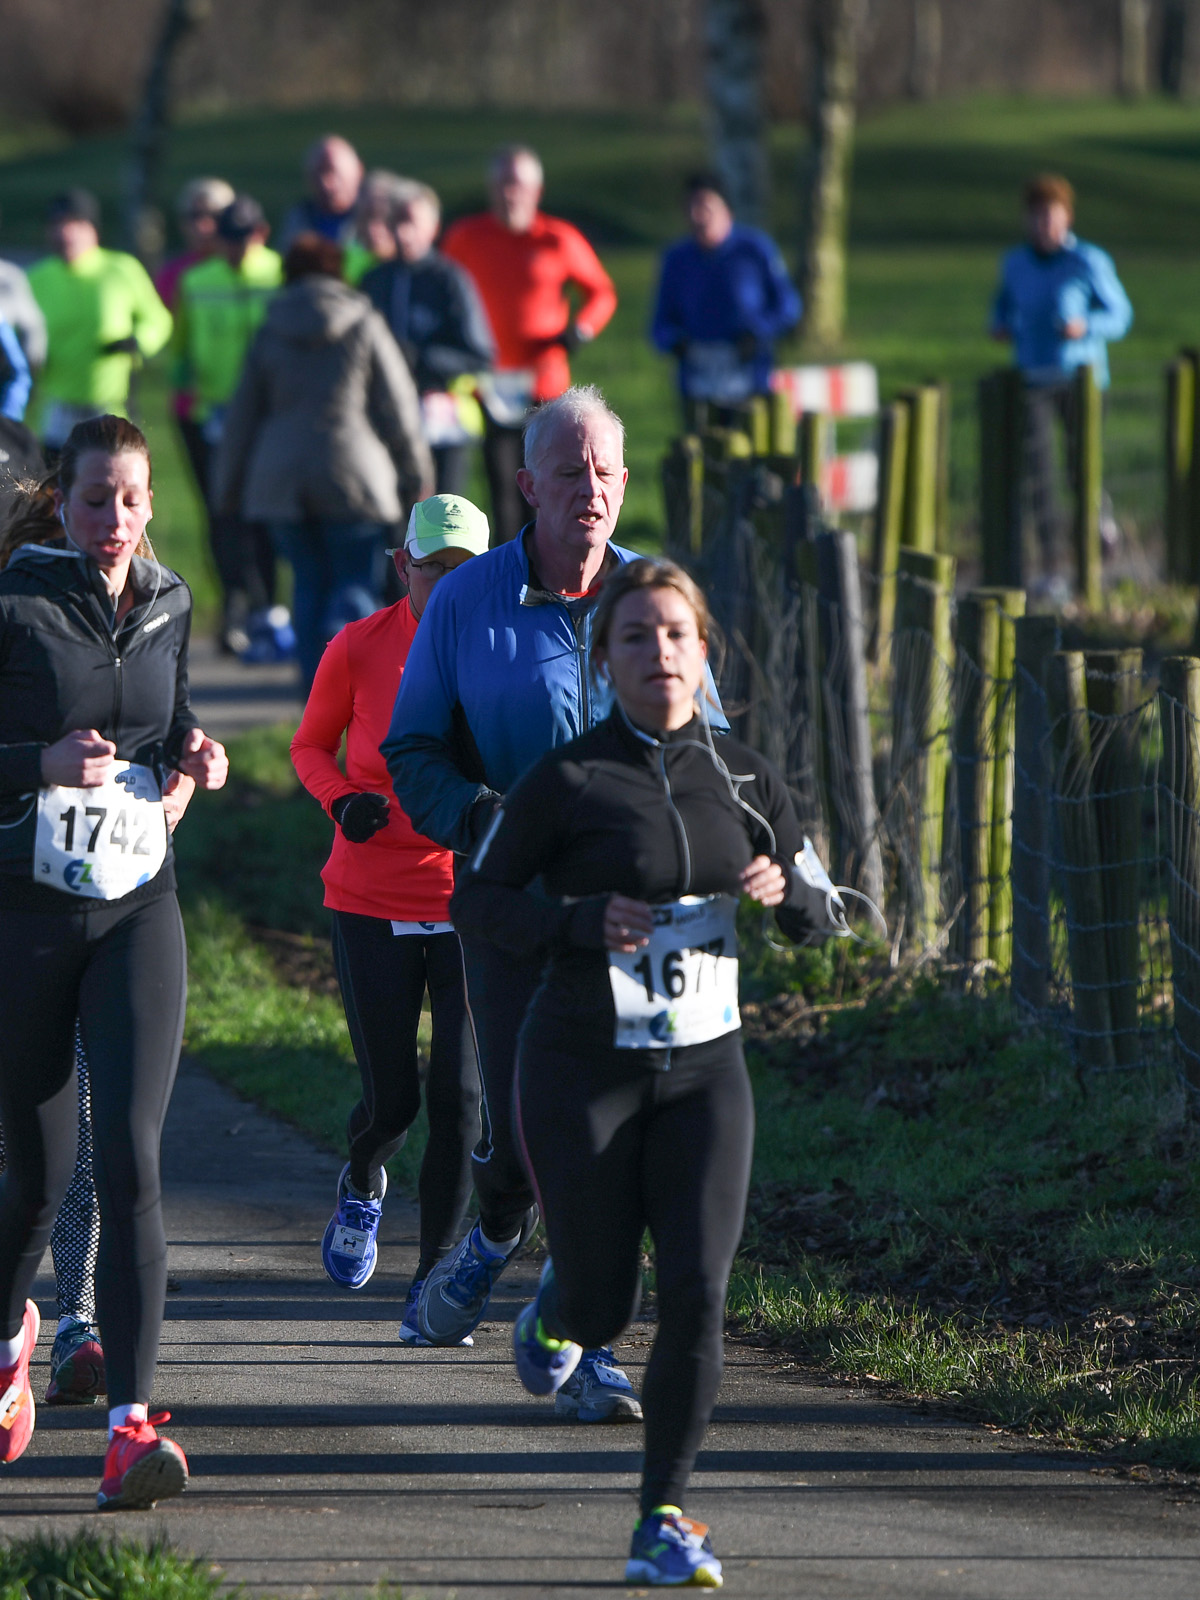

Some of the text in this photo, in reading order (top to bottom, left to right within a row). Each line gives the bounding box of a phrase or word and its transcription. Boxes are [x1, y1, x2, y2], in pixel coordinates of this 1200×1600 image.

[60, 806, 150, 856] 1742
[41, 863, 51, 874] 3
[634, 937, 725, 1003] 1677
